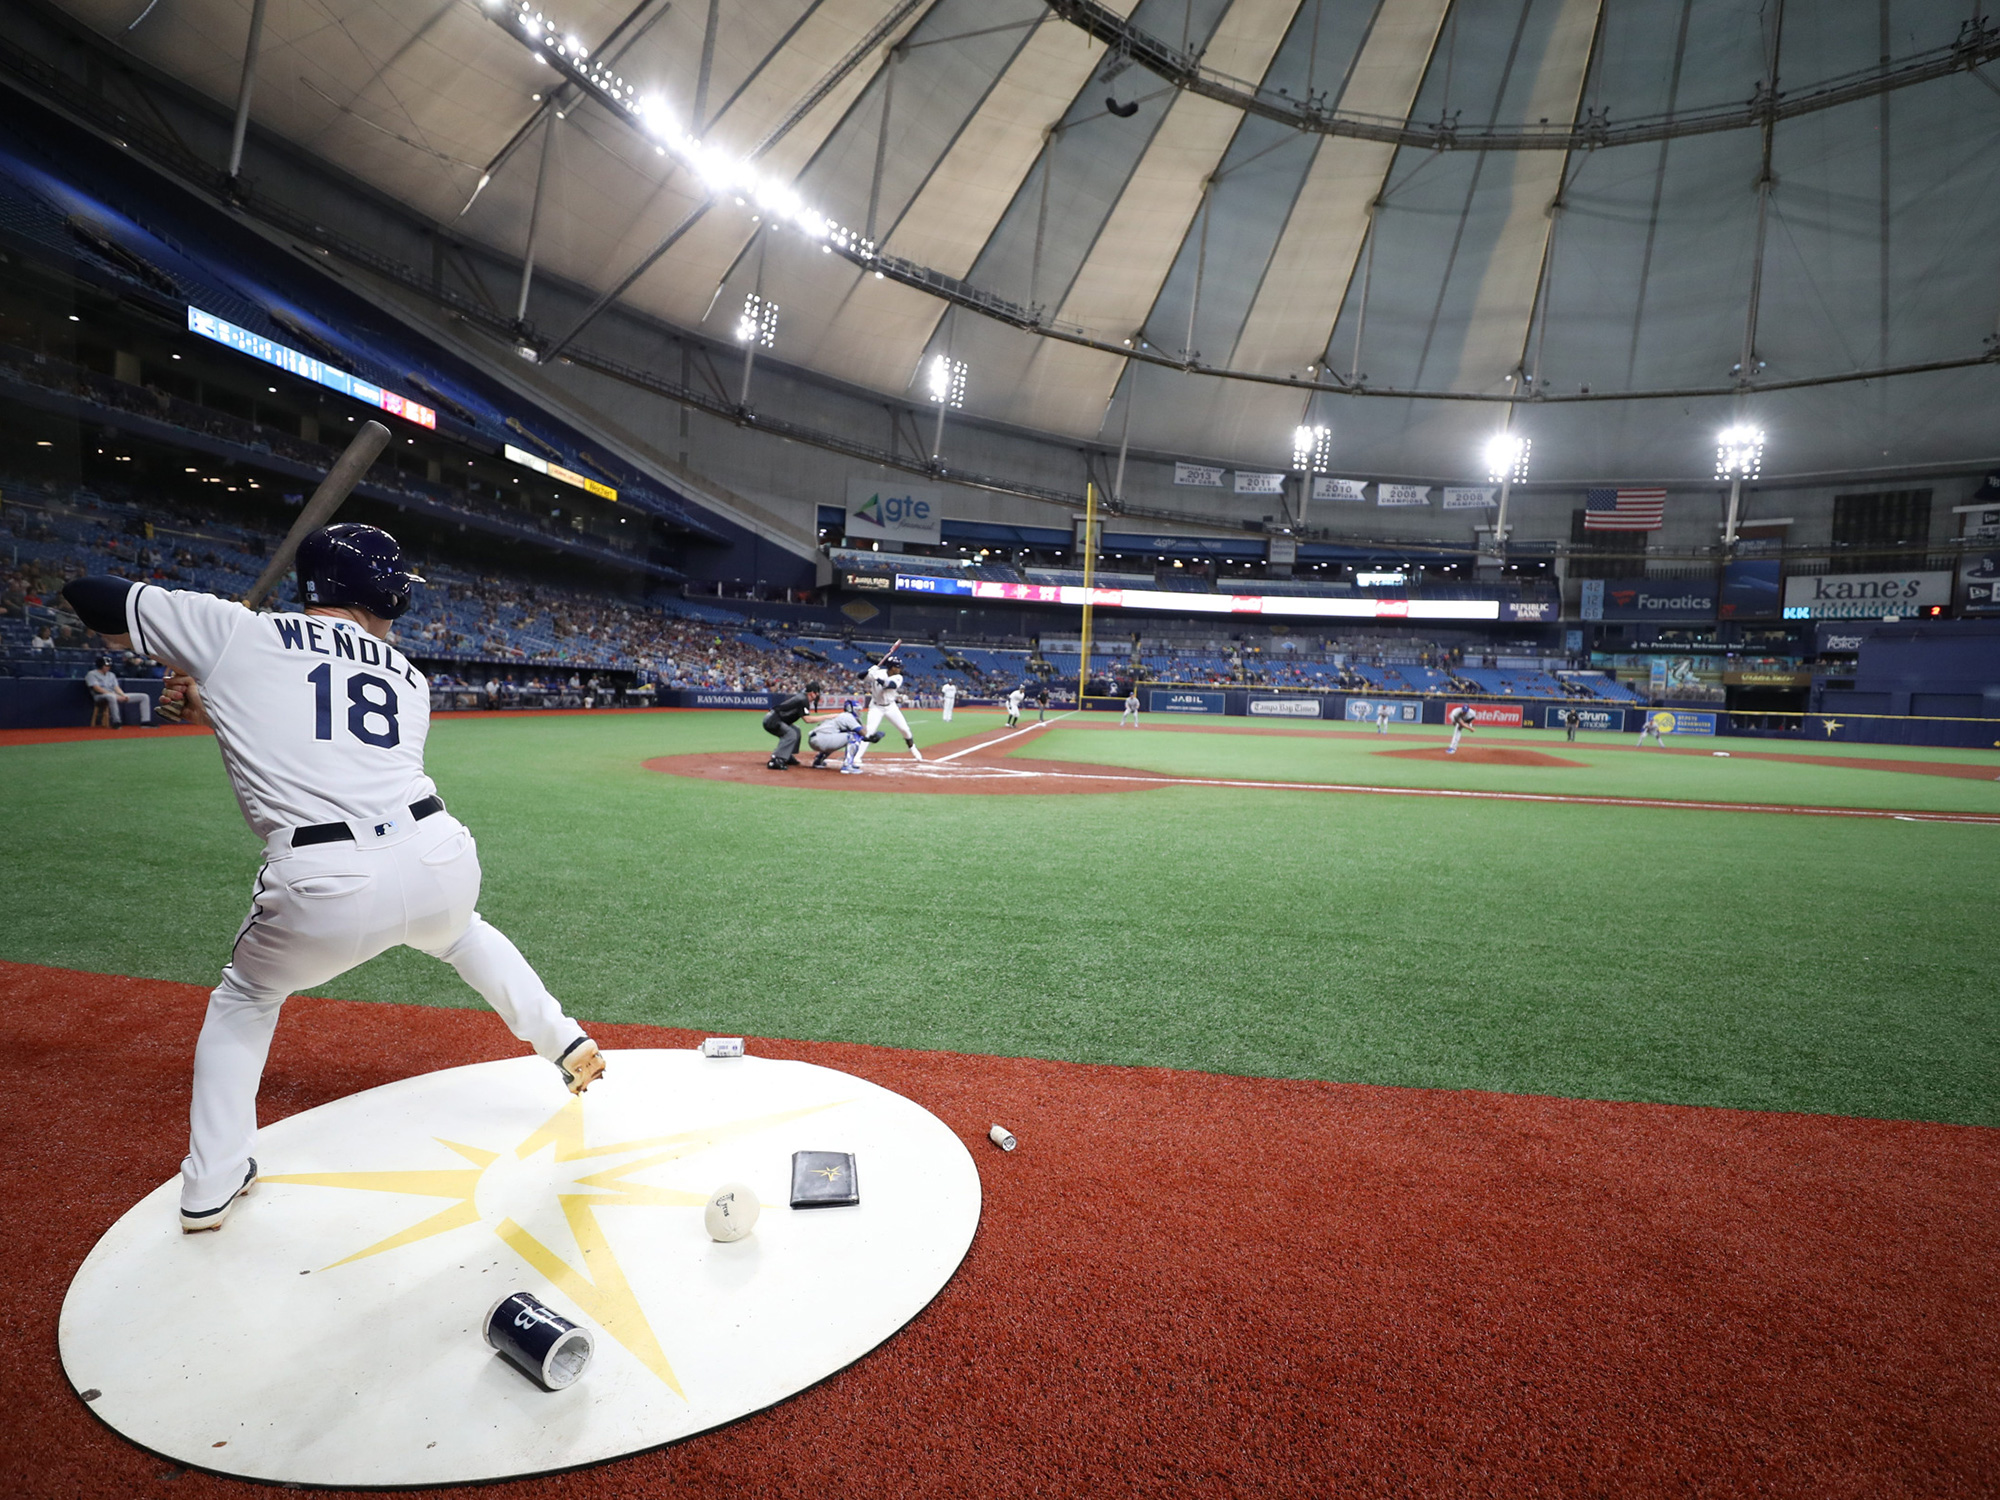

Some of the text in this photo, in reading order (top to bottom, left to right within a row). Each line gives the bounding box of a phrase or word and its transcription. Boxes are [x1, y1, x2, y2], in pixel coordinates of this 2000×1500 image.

[1187, 470, 1212, 480] 2013
[1247, 478, 1271, 487] 2011
[1325, 484, 1352, 493] 2010
[1390, 490, 1417, 498] 2008
[1456, 493, 1484, 501] 2008
[885, 495, 931, 522] gte
[1586, 582, 1600, 592] 42
[1813, 577, 1921, 600] kane's
[1586, 595, 1599, 604] 12
[1638, 594, 1712, 610] Fanatics
[1509, 603, 1549, 611] REPUBLIC
[1517, 610, 1541, 618] BANK
[1584, 608, 1599, 618] 66
[273, 618, 418, 690] WENDLE
[697, 695, 769, 705] RAYMOND JAMES
[1171, 695, 1203, 703] JABIL
[307, 662, 400, 750] 18
[1254, 703, 1317, 713] Tampa Bay Times
